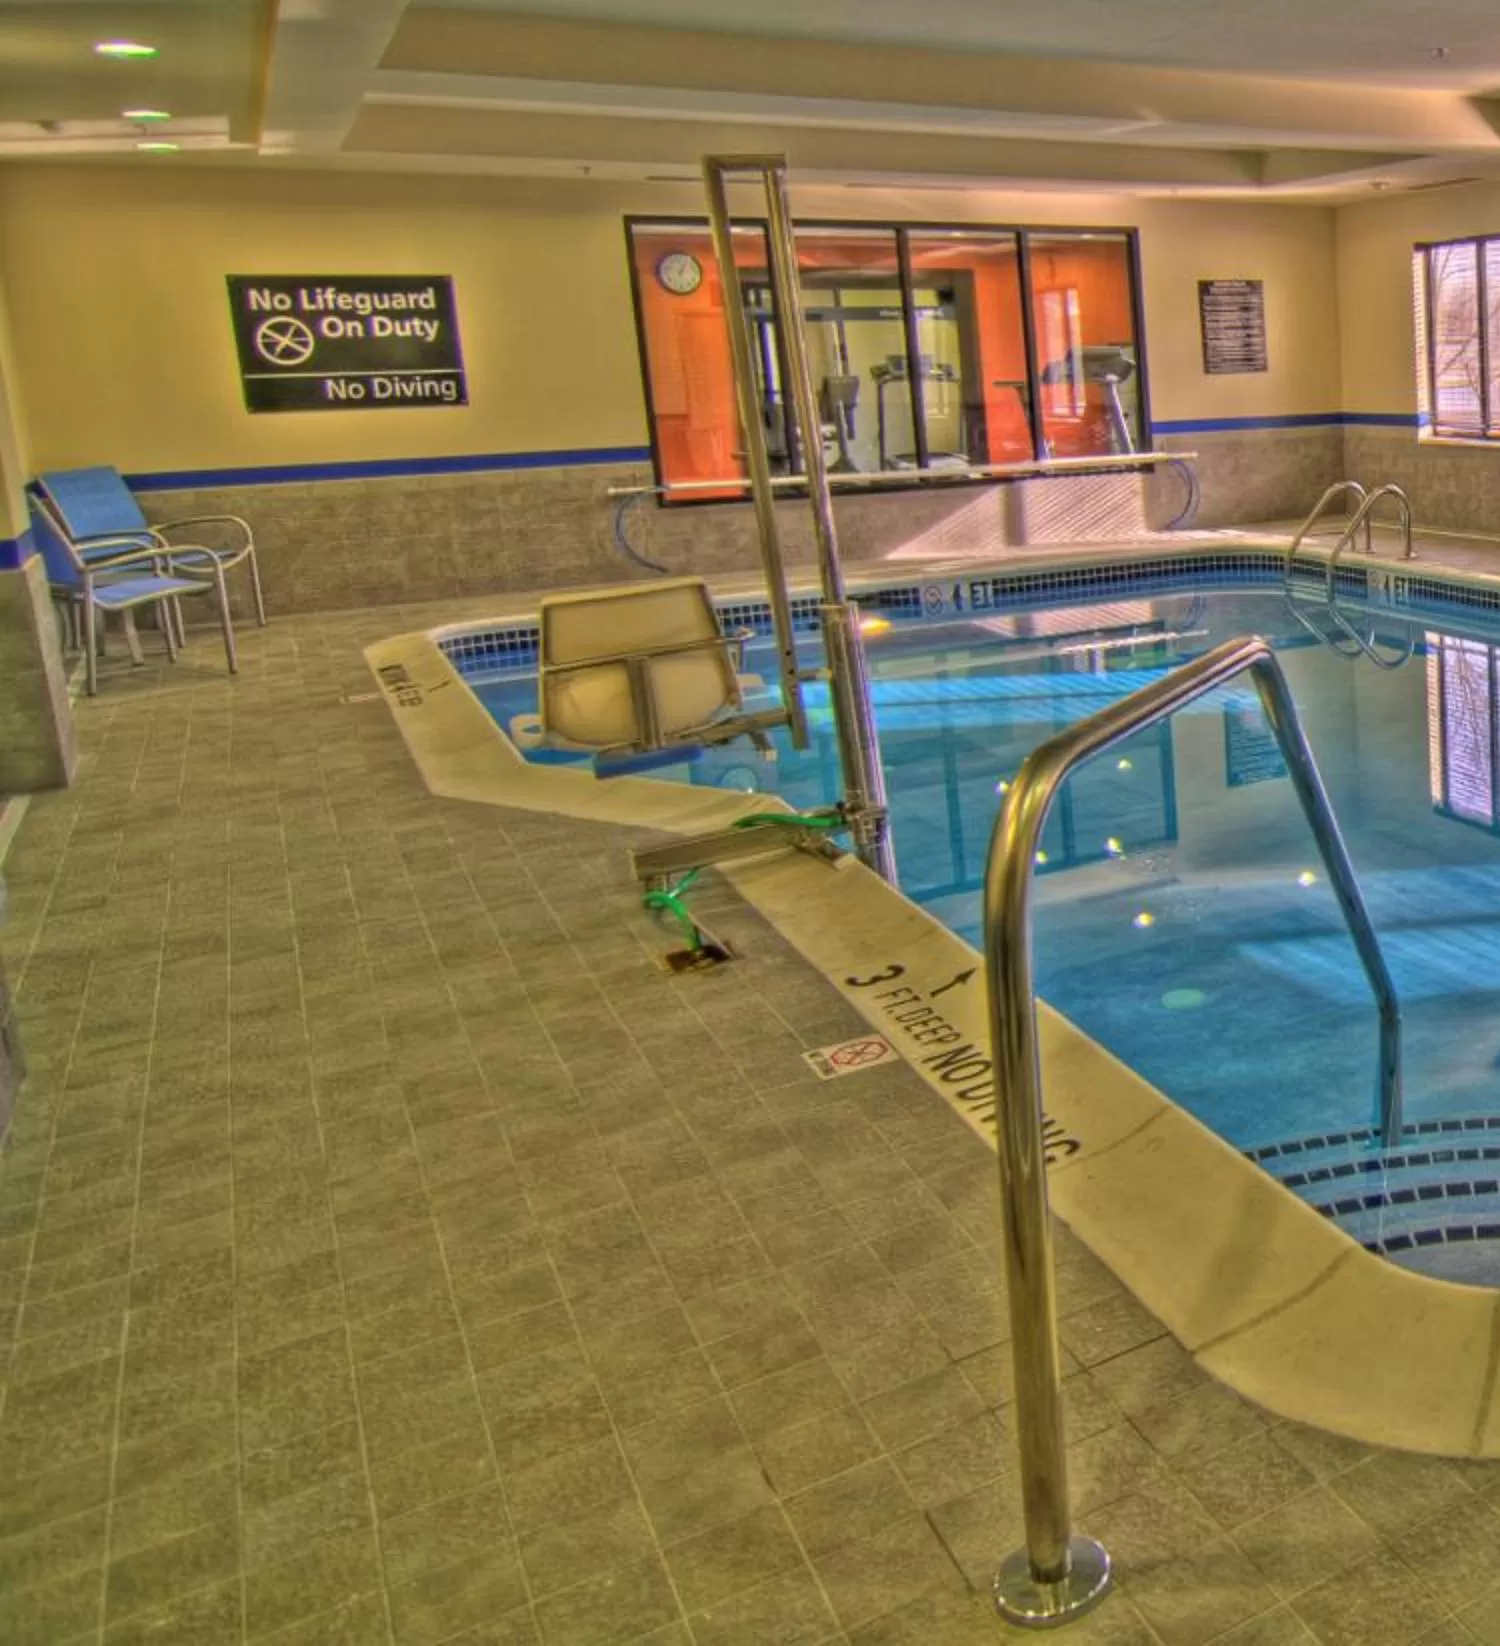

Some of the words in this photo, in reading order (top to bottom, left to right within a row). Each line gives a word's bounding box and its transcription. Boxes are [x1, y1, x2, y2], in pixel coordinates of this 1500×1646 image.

[249, 288, 292, 311] No
[300, 287, 436, 315] Lifeguard
[321, 316, 364, 338] On
[371, 316, 440, 342] Duty
[325, 378, 365, 400] No
[371, 376, 458, 401] Diving
[845, 963, 905, 988] 3
[920, 1043, 993, 1083] NO
